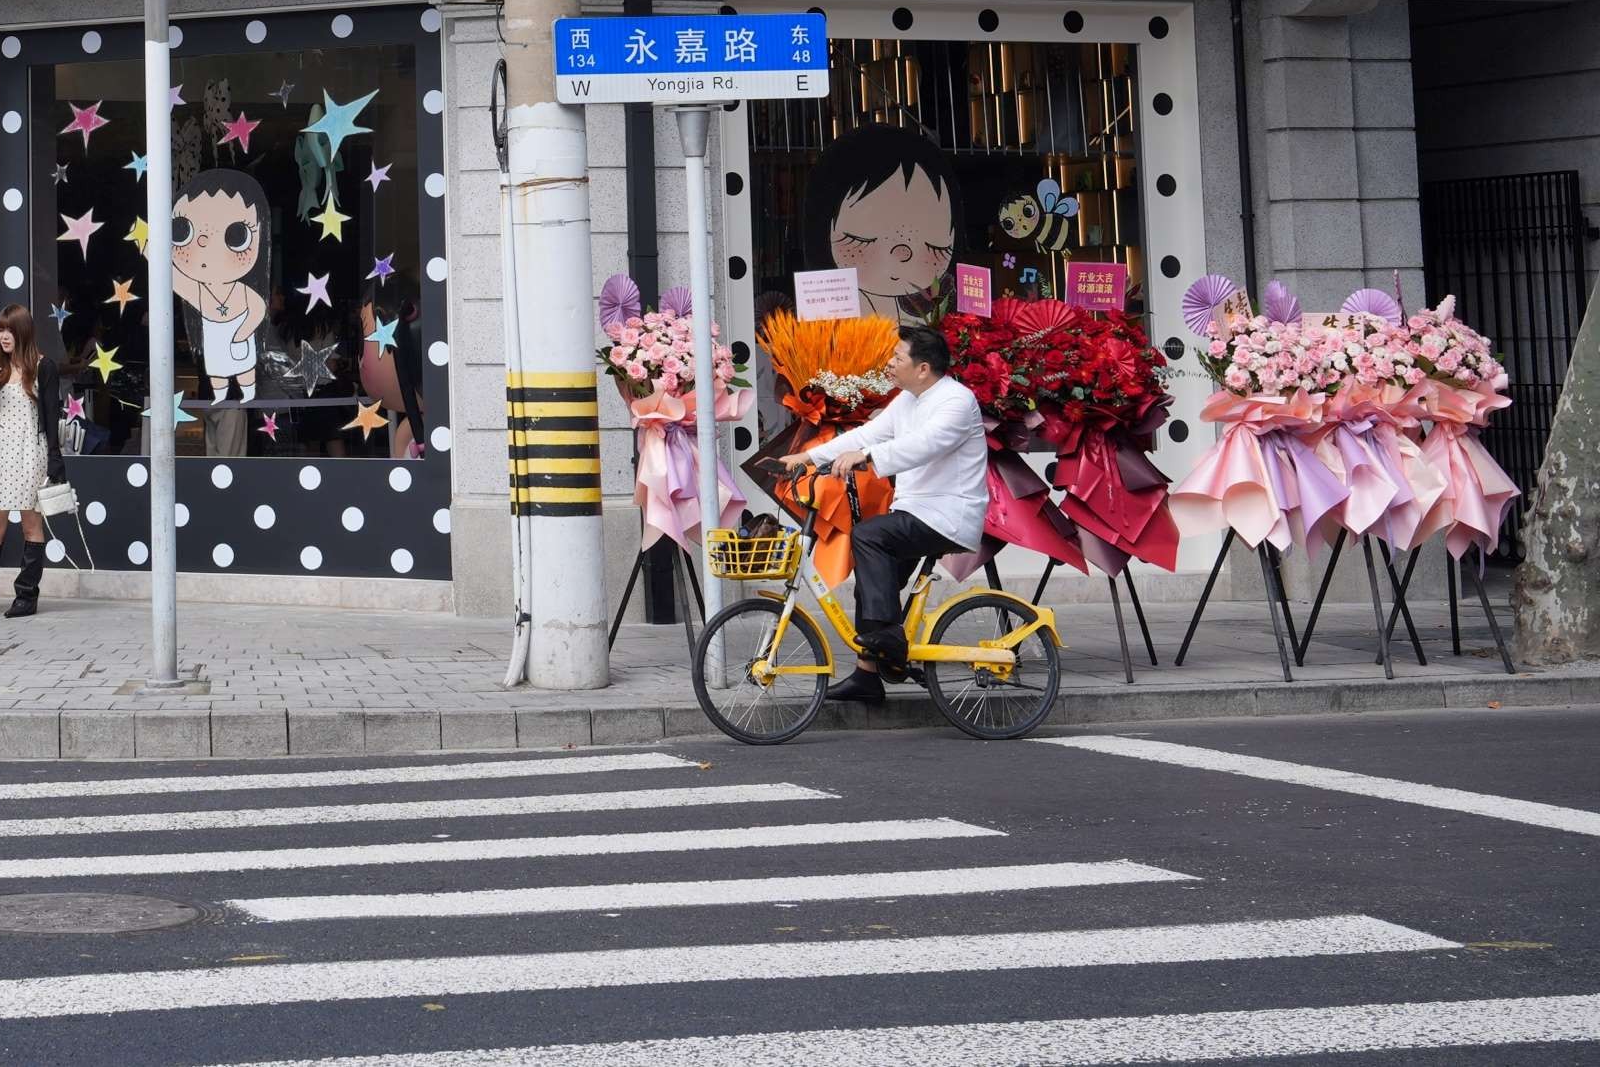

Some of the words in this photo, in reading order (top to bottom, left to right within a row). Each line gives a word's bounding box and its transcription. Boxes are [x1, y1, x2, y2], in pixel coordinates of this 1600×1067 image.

[570, 28, 591, 50] 西
[791, 25, 810, 46] 东
[625, 28, 758, 64] 永嘉路
[568, 54, 596, 68] 134
[792, 50, 811, 64] 48
[571, 80, 591, 97] W
[647, 77, 704, 93] Yongjia
[713, 75, 739, 90] Rd.
[797, 75, 809, 91] E
[1078, 272, 1113, 283] 开业大吉
